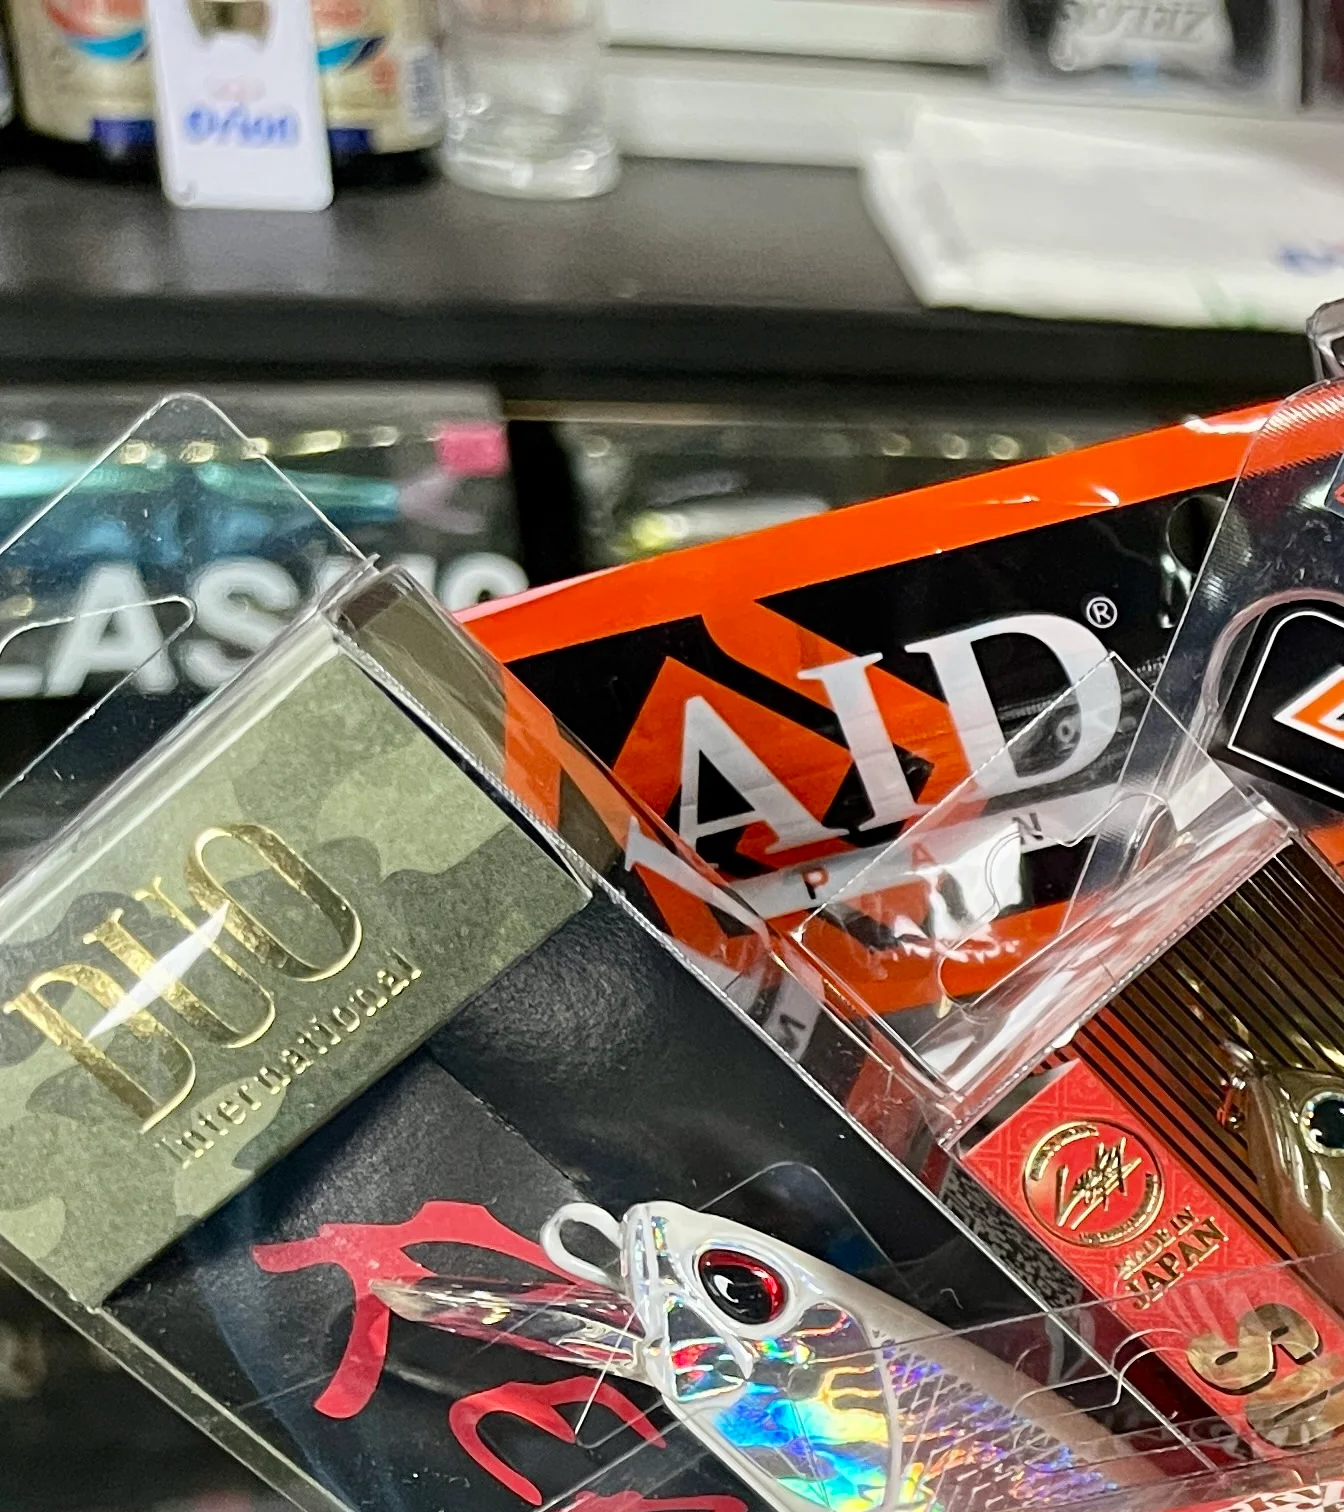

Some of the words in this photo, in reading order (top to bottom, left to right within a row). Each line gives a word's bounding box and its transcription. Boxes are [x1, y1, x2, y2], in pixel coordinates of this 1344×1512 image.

[2, 823, 363, 1134] DUO
[155, 947, 424, 1169] International
[1122, 1215, 1230, 1311] JAPAN
